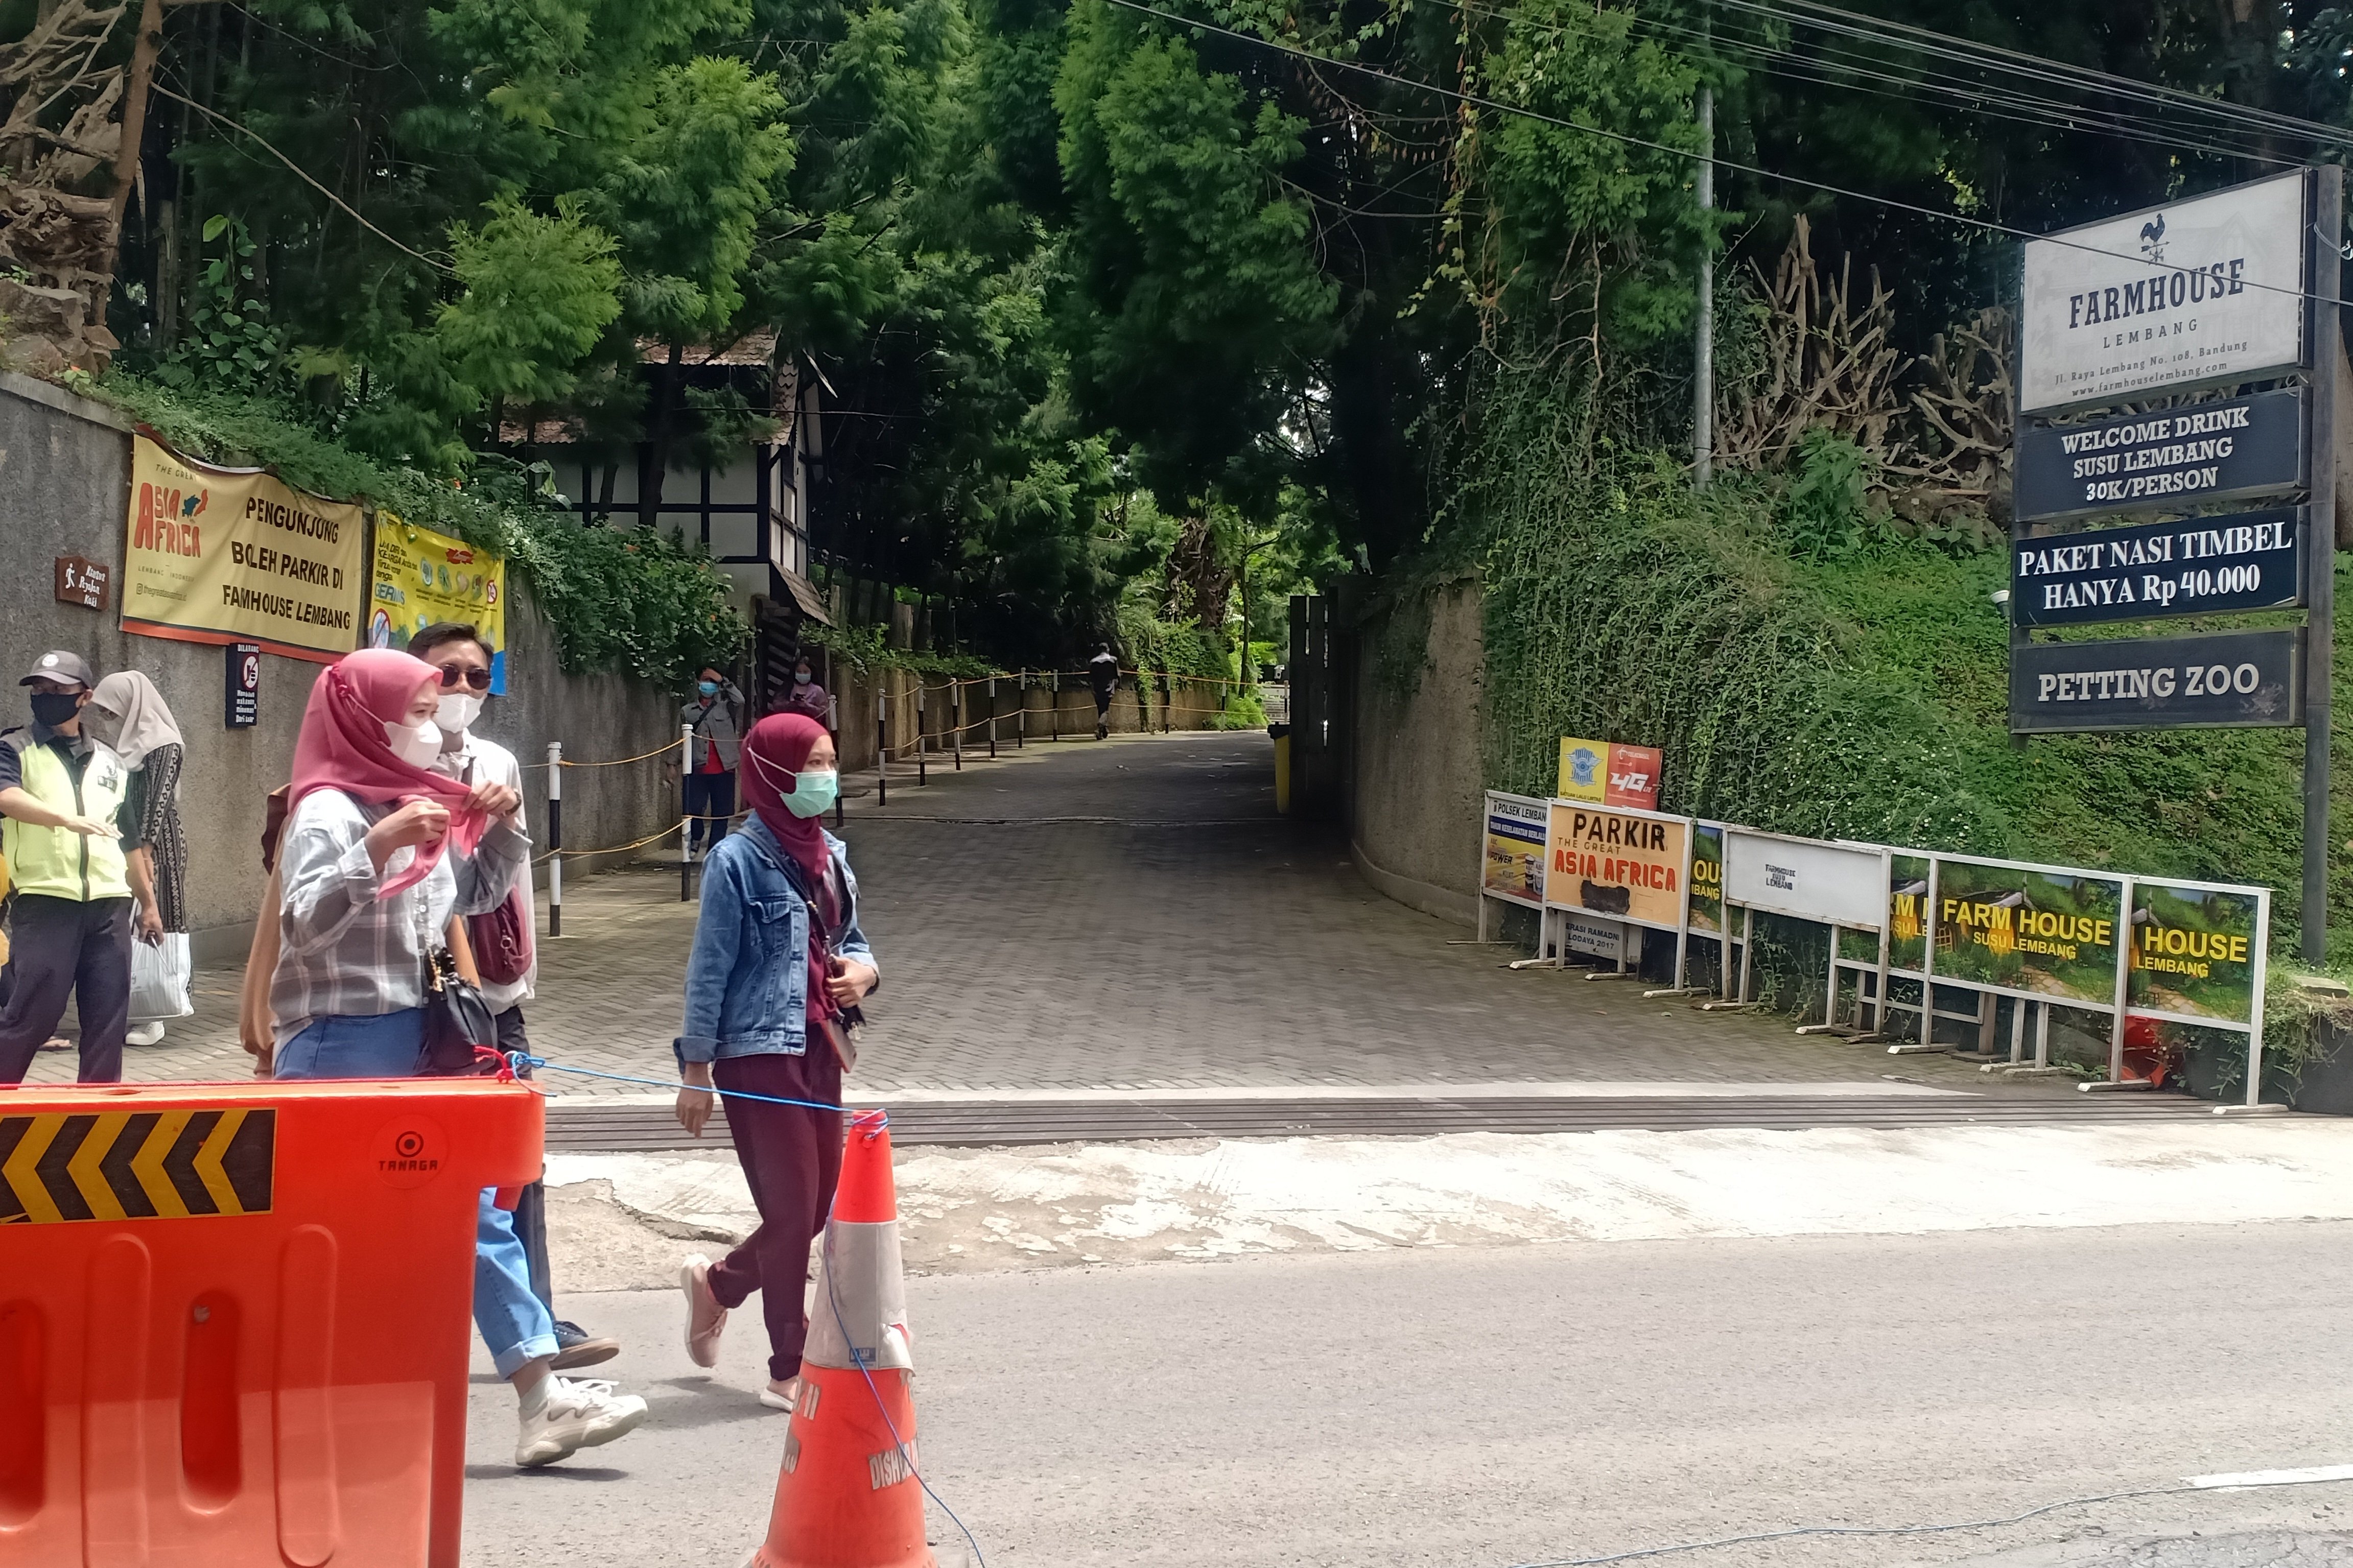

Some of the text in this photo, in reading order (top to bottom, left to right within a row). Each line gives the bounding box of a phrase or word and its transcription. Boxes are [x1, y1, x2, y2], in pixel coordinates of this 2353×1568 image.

[2069, 258, 2244, 328] FARMHOUSE
[2103, 319, 2198, 348] LEMBANG
[2072, 371, 2095, 381] Raya
[2100, 361, 2145, 375] Lembang
[2150, 356, 2168, 366] No.
[2199, 342, 2247, 357] Bandung
[2072, 363, 2227, 396] www.farmhouselembang.com
[2061, 407, 2249, 454] WELCOME DRINK
[155, 464, 172, 475] THE
[2074, 437, 2232, 479] SUSU LEMBANG
[2086, 466, 2218, 501] 30K/PERSON
[246, 497, 339, 543] PENGUNJUNG
[231, 541, 343, 590] BOLEH PARKIR DI
[2018, 521, 2292, 577] PAKET NASI TIMBEL
[2043, 564, 2261, 609] HANYA Rp 40.000
[222, 584, 351, 630] FAMHOUSE LEMBANG
[2038, 663, 2260, 701] PETTING ZOO
[1610, 772, 1649, 793] 4G
[1498, 803, 1547, 822] POLSEK LEMBAN
[1558, 837, 1621, 855] THE GREAT
[1572, 813, 1665, 852] PARKIR
[1555, 849, 1676, 892] ASIA AFRICA
[1566, 922, 1586, 933] ERASI
[1568, 933, 1614, 949] LODAYA 2017
[1943, 899, 2011, 931] FARM
[2019, 908, 2111, 946] HOUSE
[1973, 931, 2077, 959] SUSU LEMBANG
[2145, 926, 2248, 962] HOUSE
[2135, 956, 2208, 978] LEMBANG
[379, 1160, 438, 1171] TANAGA
